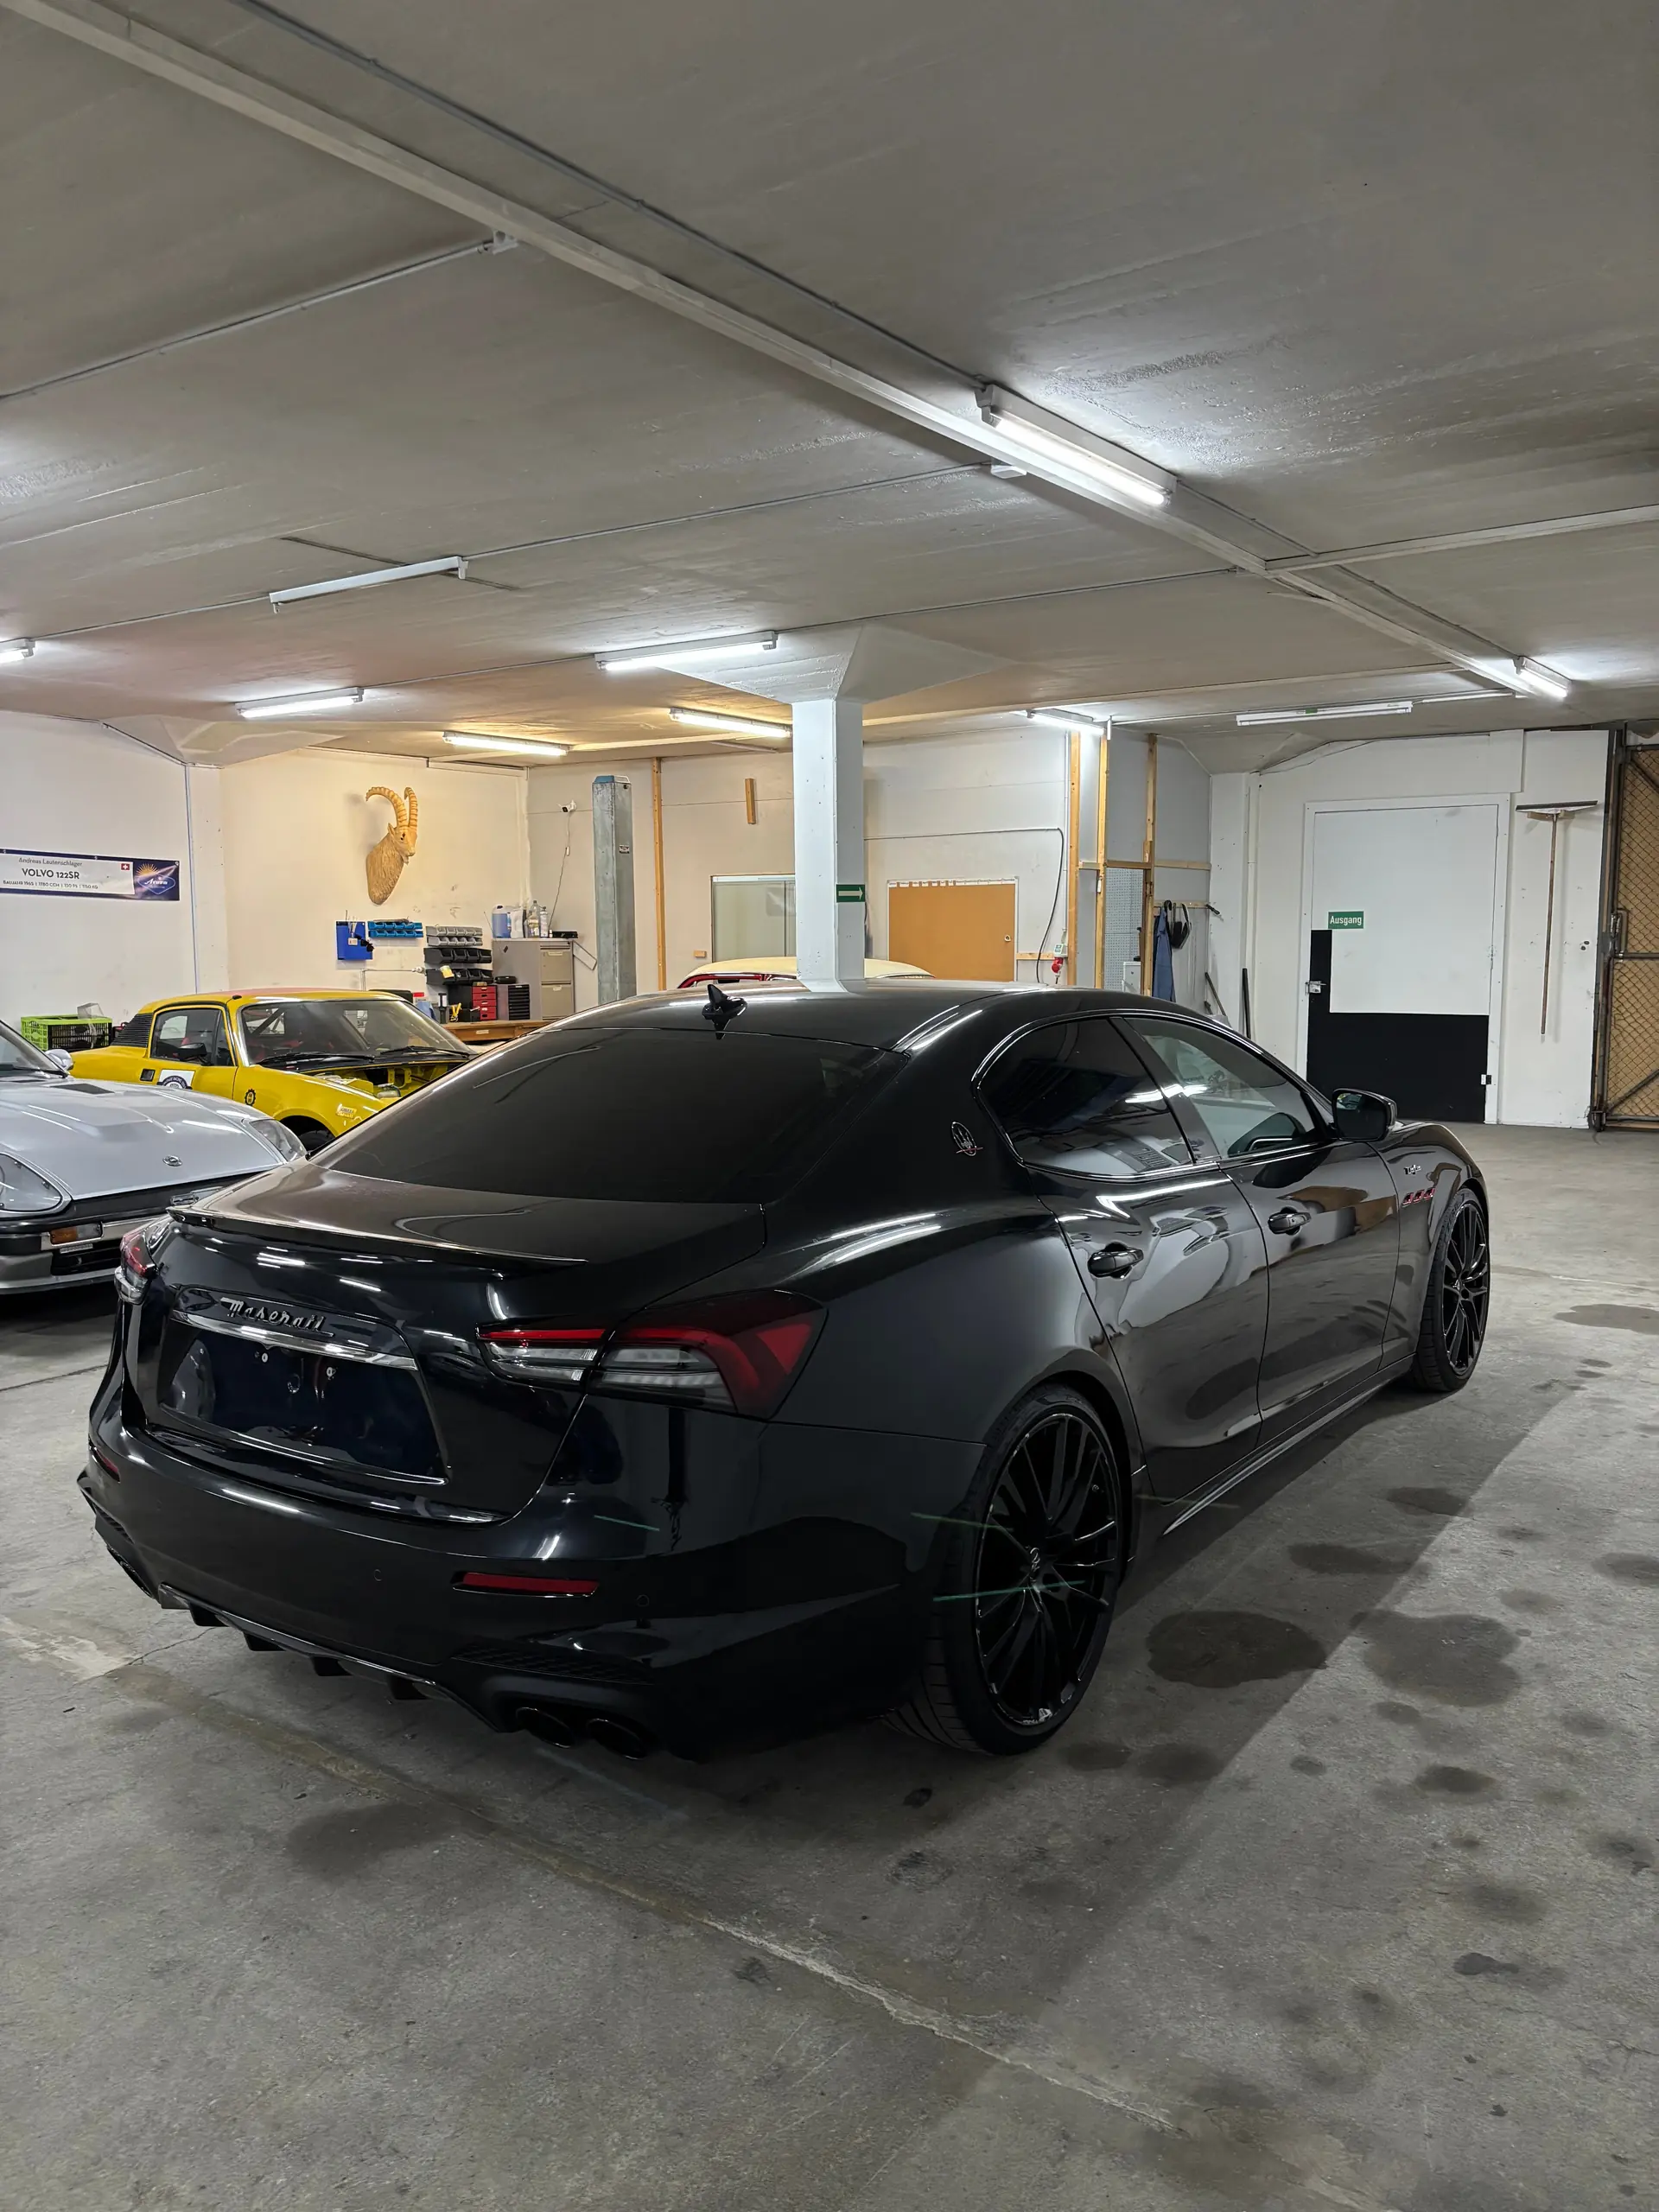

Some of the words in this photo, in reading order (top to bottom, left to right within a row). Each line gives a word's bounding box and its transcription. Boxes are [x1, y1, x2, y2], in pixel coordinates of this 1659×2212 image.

[22, 868, 54, 878] VOLVO
[56, 871, 79, 880] 122SR
[1330, 915, 1363, 926] Ausgang
[219, 1297, 334, 1337] Maserati
